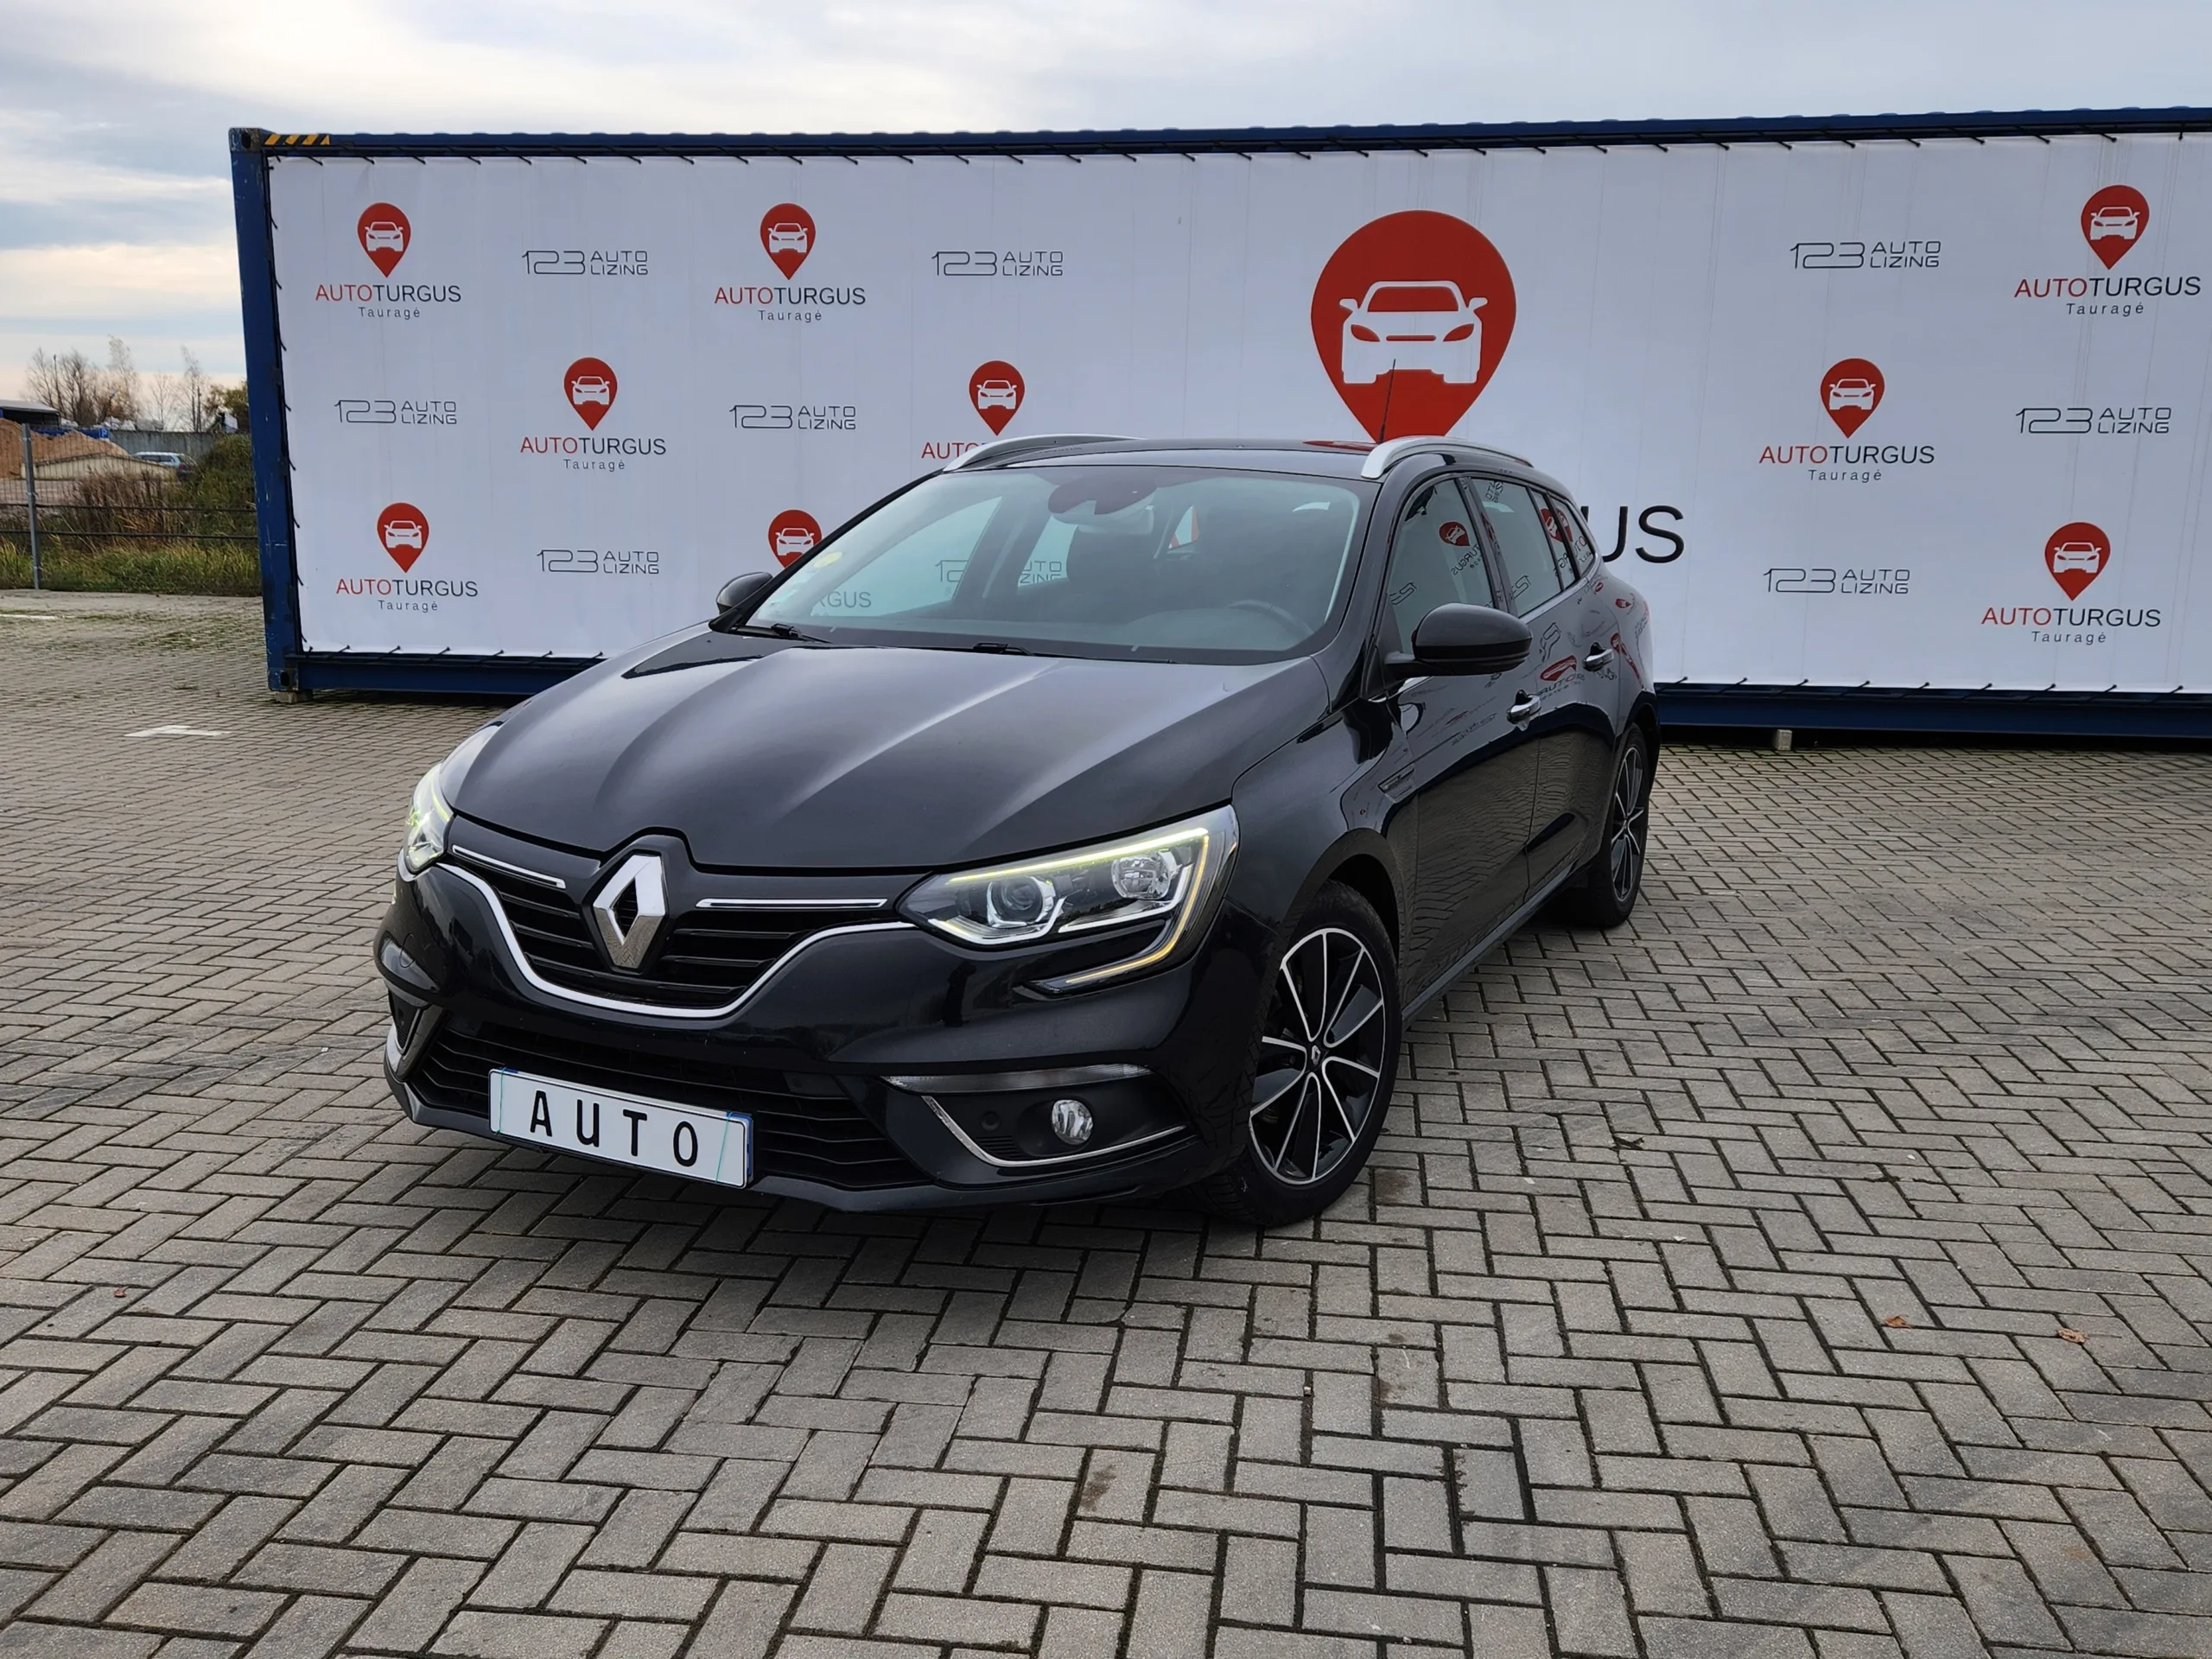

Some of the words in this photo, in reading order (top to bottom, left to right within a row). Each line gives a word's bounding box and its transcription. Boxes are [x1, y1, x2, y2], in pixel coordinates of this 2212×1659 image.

[522, 251, 585, 275] 123
[590, 251, 647, 262] AUTO
[931, 251, 997, 276] 123
[1003, 251, 1063, 263] AUTO
[1790, 242, 1866, 269] 123
[1871, 241, 1941, 254] AUTO
[1870, 256, 1939, 268] LIZING
[591, 264, 648, 275] LIZING
[1002, 265, 1063, 276] LIZING
[315, 284, 461, 302] AUTOTURGUS
[2014, 276, 2201, 297] AUTOTURGUS
[715, 287, 866, 305] AUTOTURGUS
[334, 400, 397, 423] 123
[401, 401, 456, 412] AUTO
[402, 414, 457, 424] LIZING
[729, 405, 792, 429] 123
[798, 405, 855, 417] AUTO
[2016, 408, 2093, 434] 123
[2099, 407, 2171, 420] AUTO
[798, 419, 855, 429] LIZING
[2098, 422, 2169, 434] LIZING
[520, 437, 666, 455] AUTOTURGUS
[1759, 446, 1935, 464] AUTOTURGUS
[537, 550, 599, 573] 123
[603, 550, 658, 563] AUTO
[603, 563, 659, 574] LIZING
[336, 579, 478, 597] AUTOTURGUS
[1763, 569, 1836, 593] 123
[1842, 569, 1910, 582] AUTO
[1841, 582, 1908, 594] LIZING
[1981, 607, 2160, 627] AUTOTURGUS
